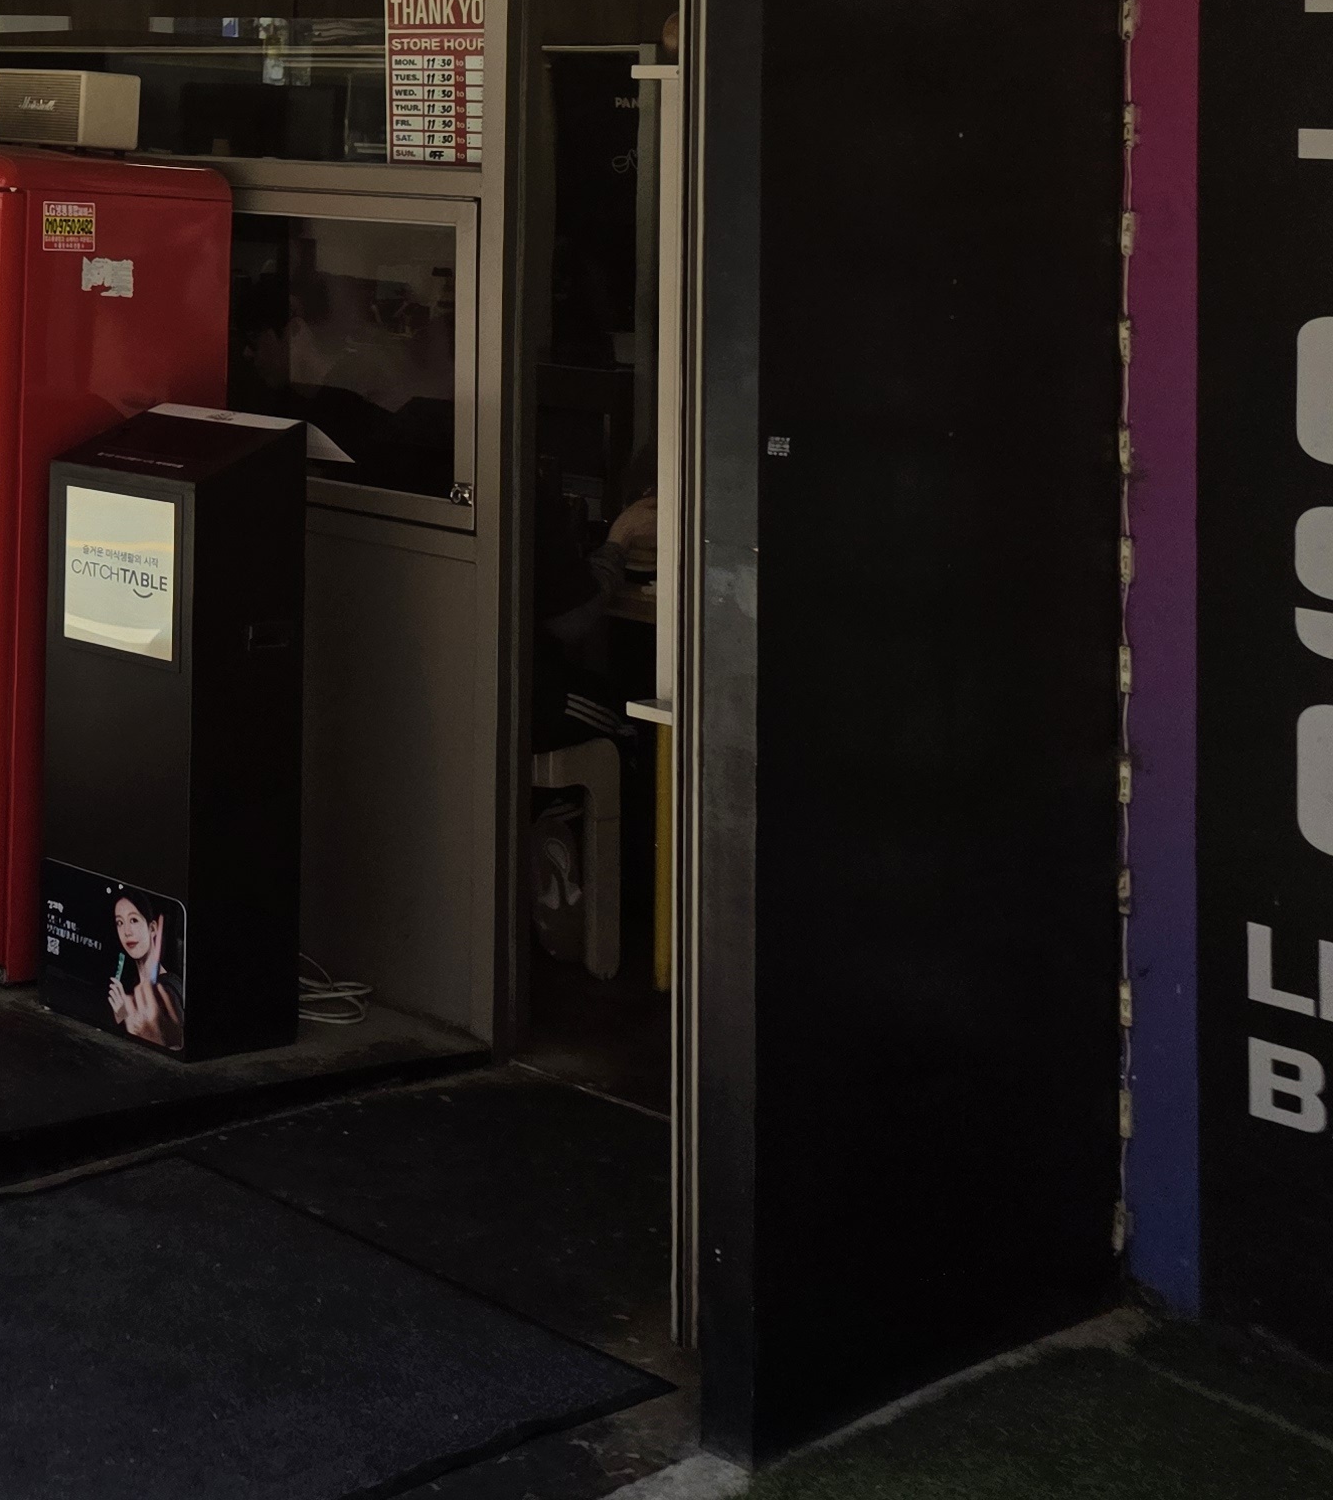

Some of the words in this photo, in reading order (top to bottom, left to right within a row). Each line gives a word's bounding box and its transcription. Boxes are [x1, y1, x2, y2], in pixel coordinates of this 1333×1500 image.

[391, 38, 441, 50] STORE
[394, 58, 418, 66] MON.
[394, 73, 420, 81] TUES.
[394, 89, 417, 97] WED.
[456, 90, 465, 98] to
[395, 104, 421, 112] THUR.
[395, 119, 412, 127] FRI.
[457, 121, 465, 129] to
[395, 134, 414, 142] SAT.
[71, 558, 168, 592] CATCHTABLE
